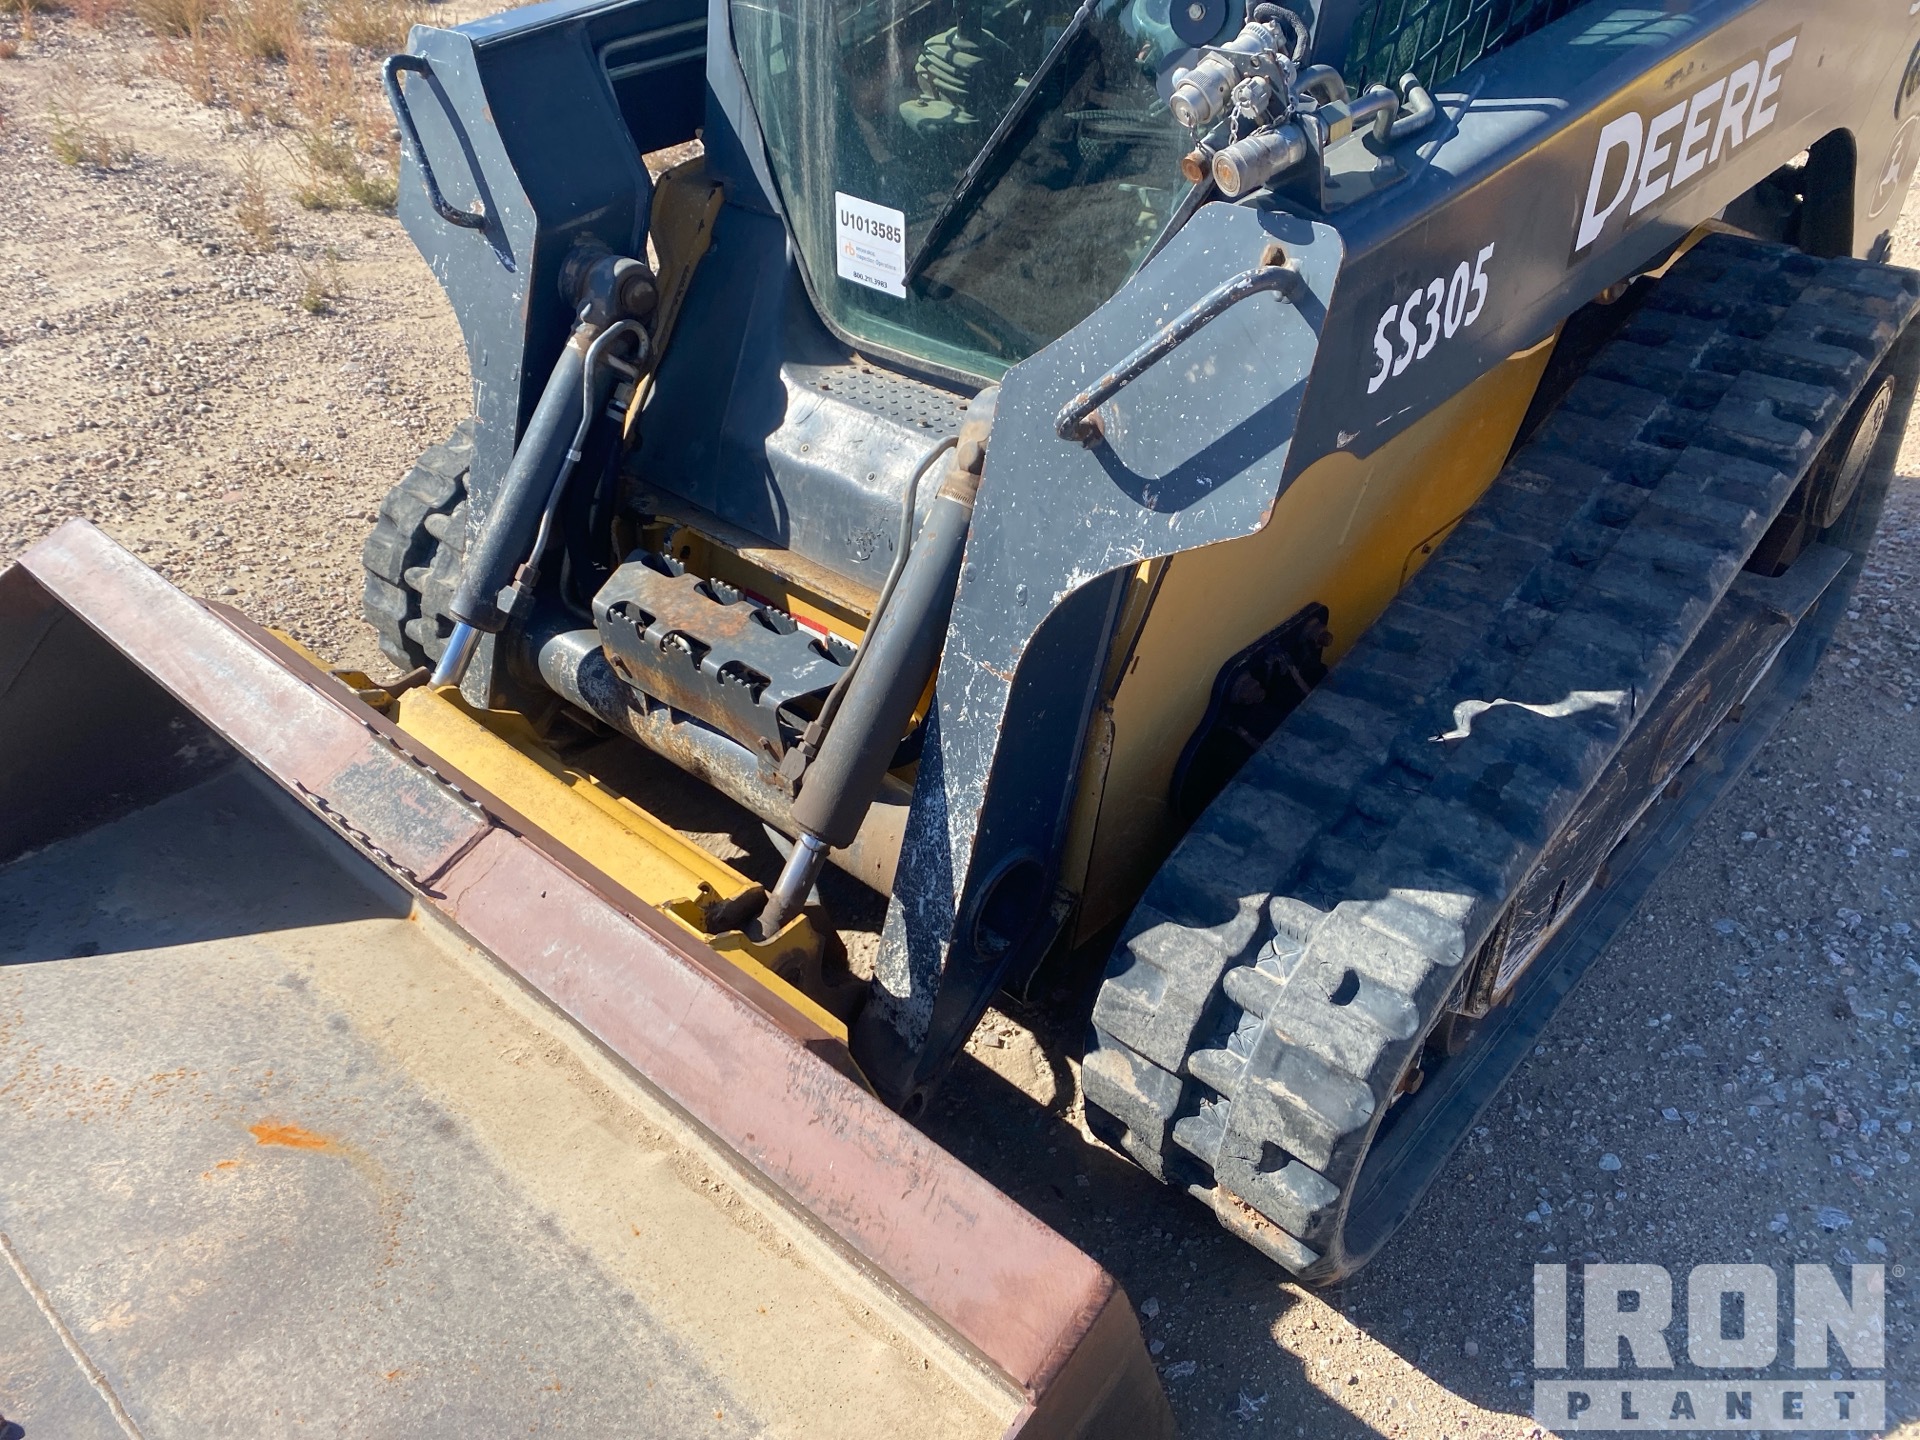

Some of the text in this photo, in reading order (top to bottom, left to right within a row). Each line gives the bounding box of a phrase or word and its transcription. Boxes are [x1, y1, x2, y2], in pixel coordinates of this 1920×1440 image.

[1575, 36, 1797, 252] DEERE
[841, 209, 901, 243] U1013585
[1367, 242, 1494, 394] SS305
